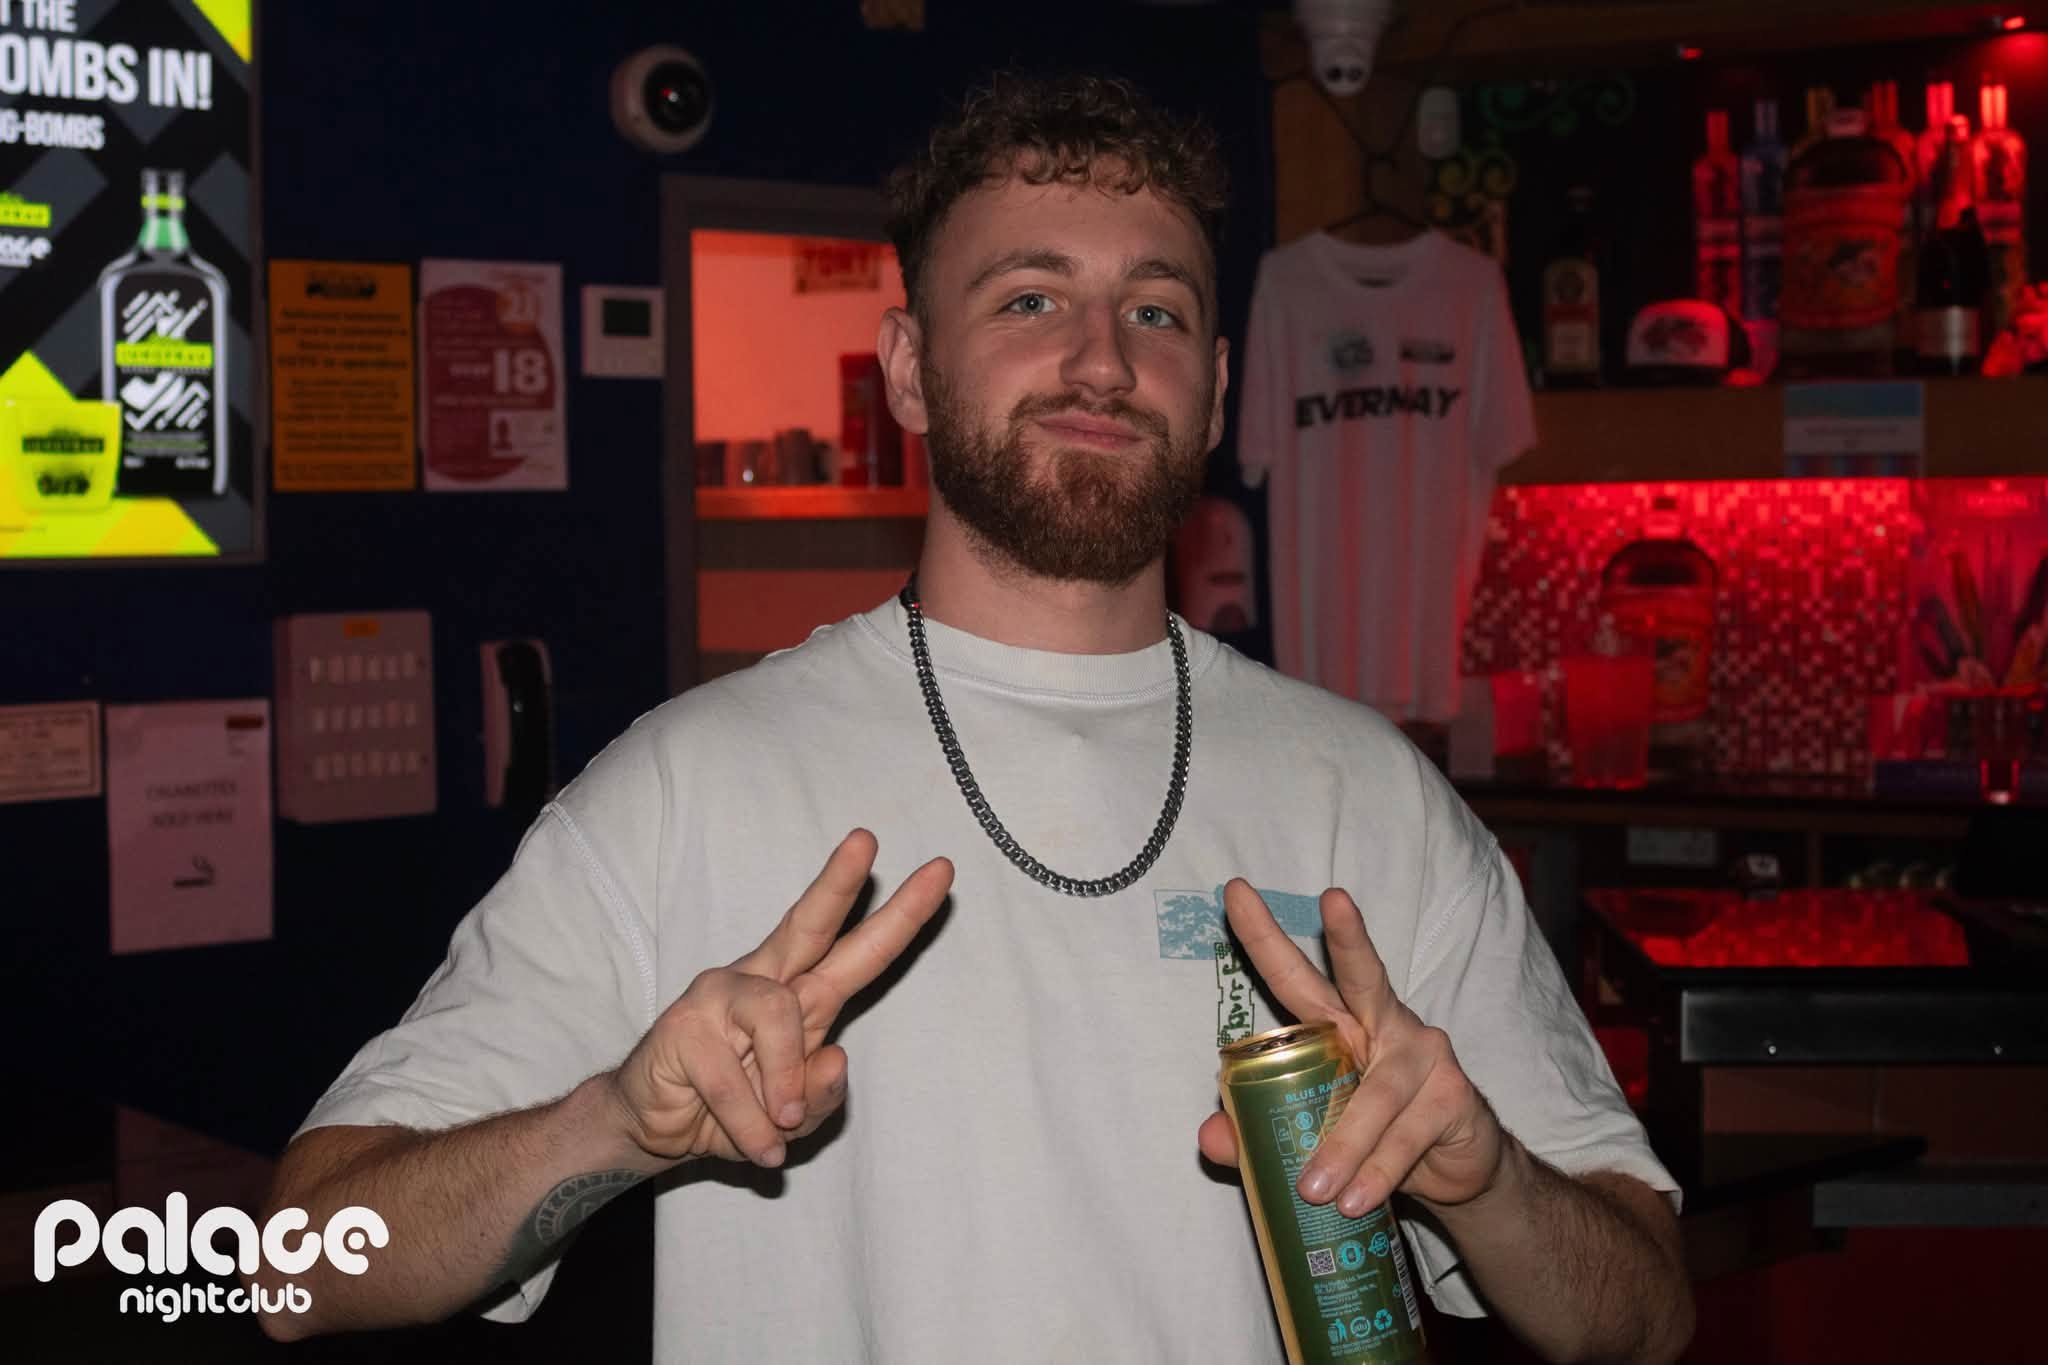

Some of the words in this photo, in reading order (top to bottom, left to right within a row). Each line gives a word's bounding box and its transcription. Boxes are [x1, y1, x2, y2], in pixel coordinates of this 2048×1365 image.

[22, 0, 77, 33] THE
[148, 47, 212, 111] IN!
[493, 348, 549, 395] 18
[1285, 1088, 1315, 1104] BLUE
